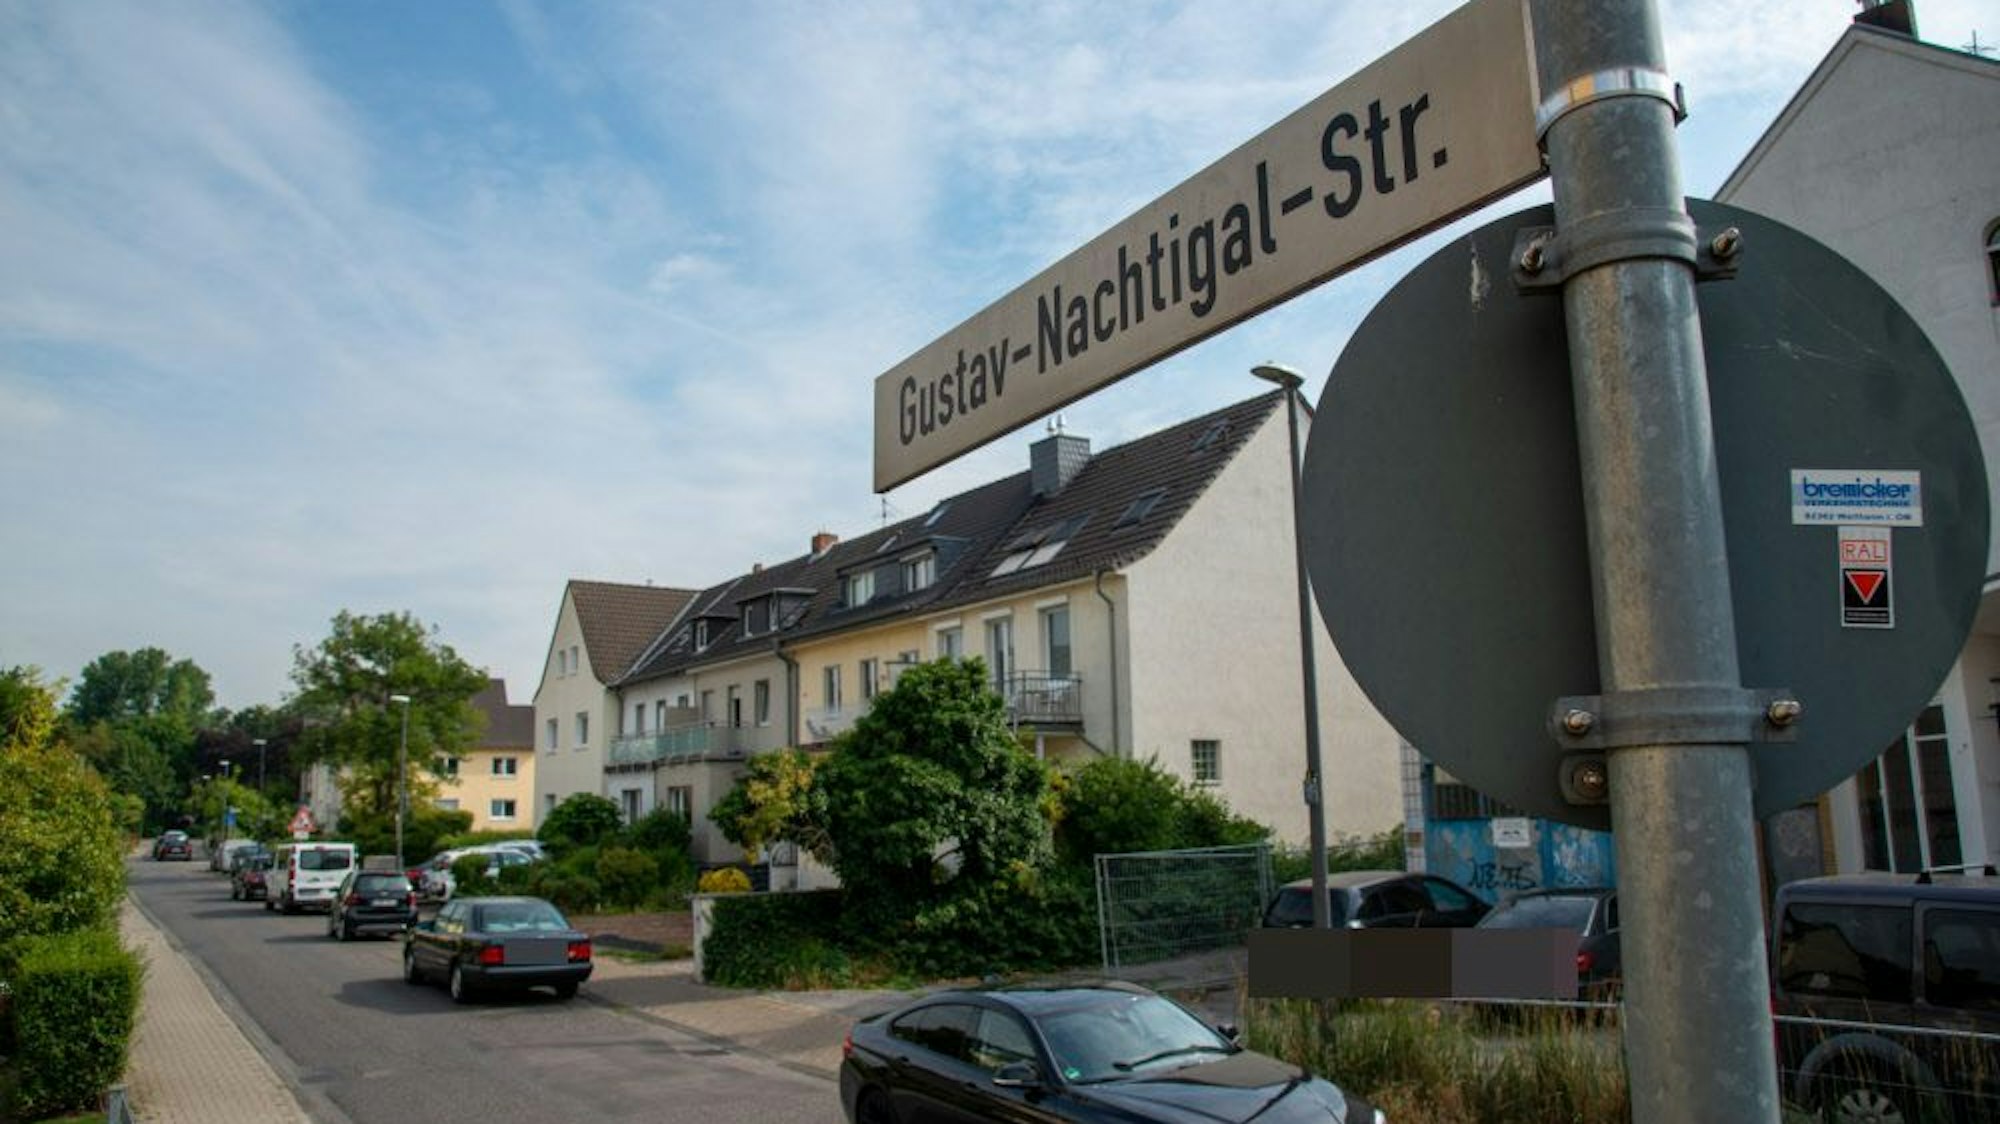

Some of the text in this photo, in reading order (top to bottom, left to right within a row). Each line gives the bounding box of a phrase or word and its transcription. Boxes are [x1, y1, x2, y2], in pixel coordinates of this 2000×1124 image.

[899, 92, 1450, 446] Gustav-Nachtigal-Str.
[1803, 476, 1911, 498] bremicker
[1845, 543, 1883, 559] RAL
